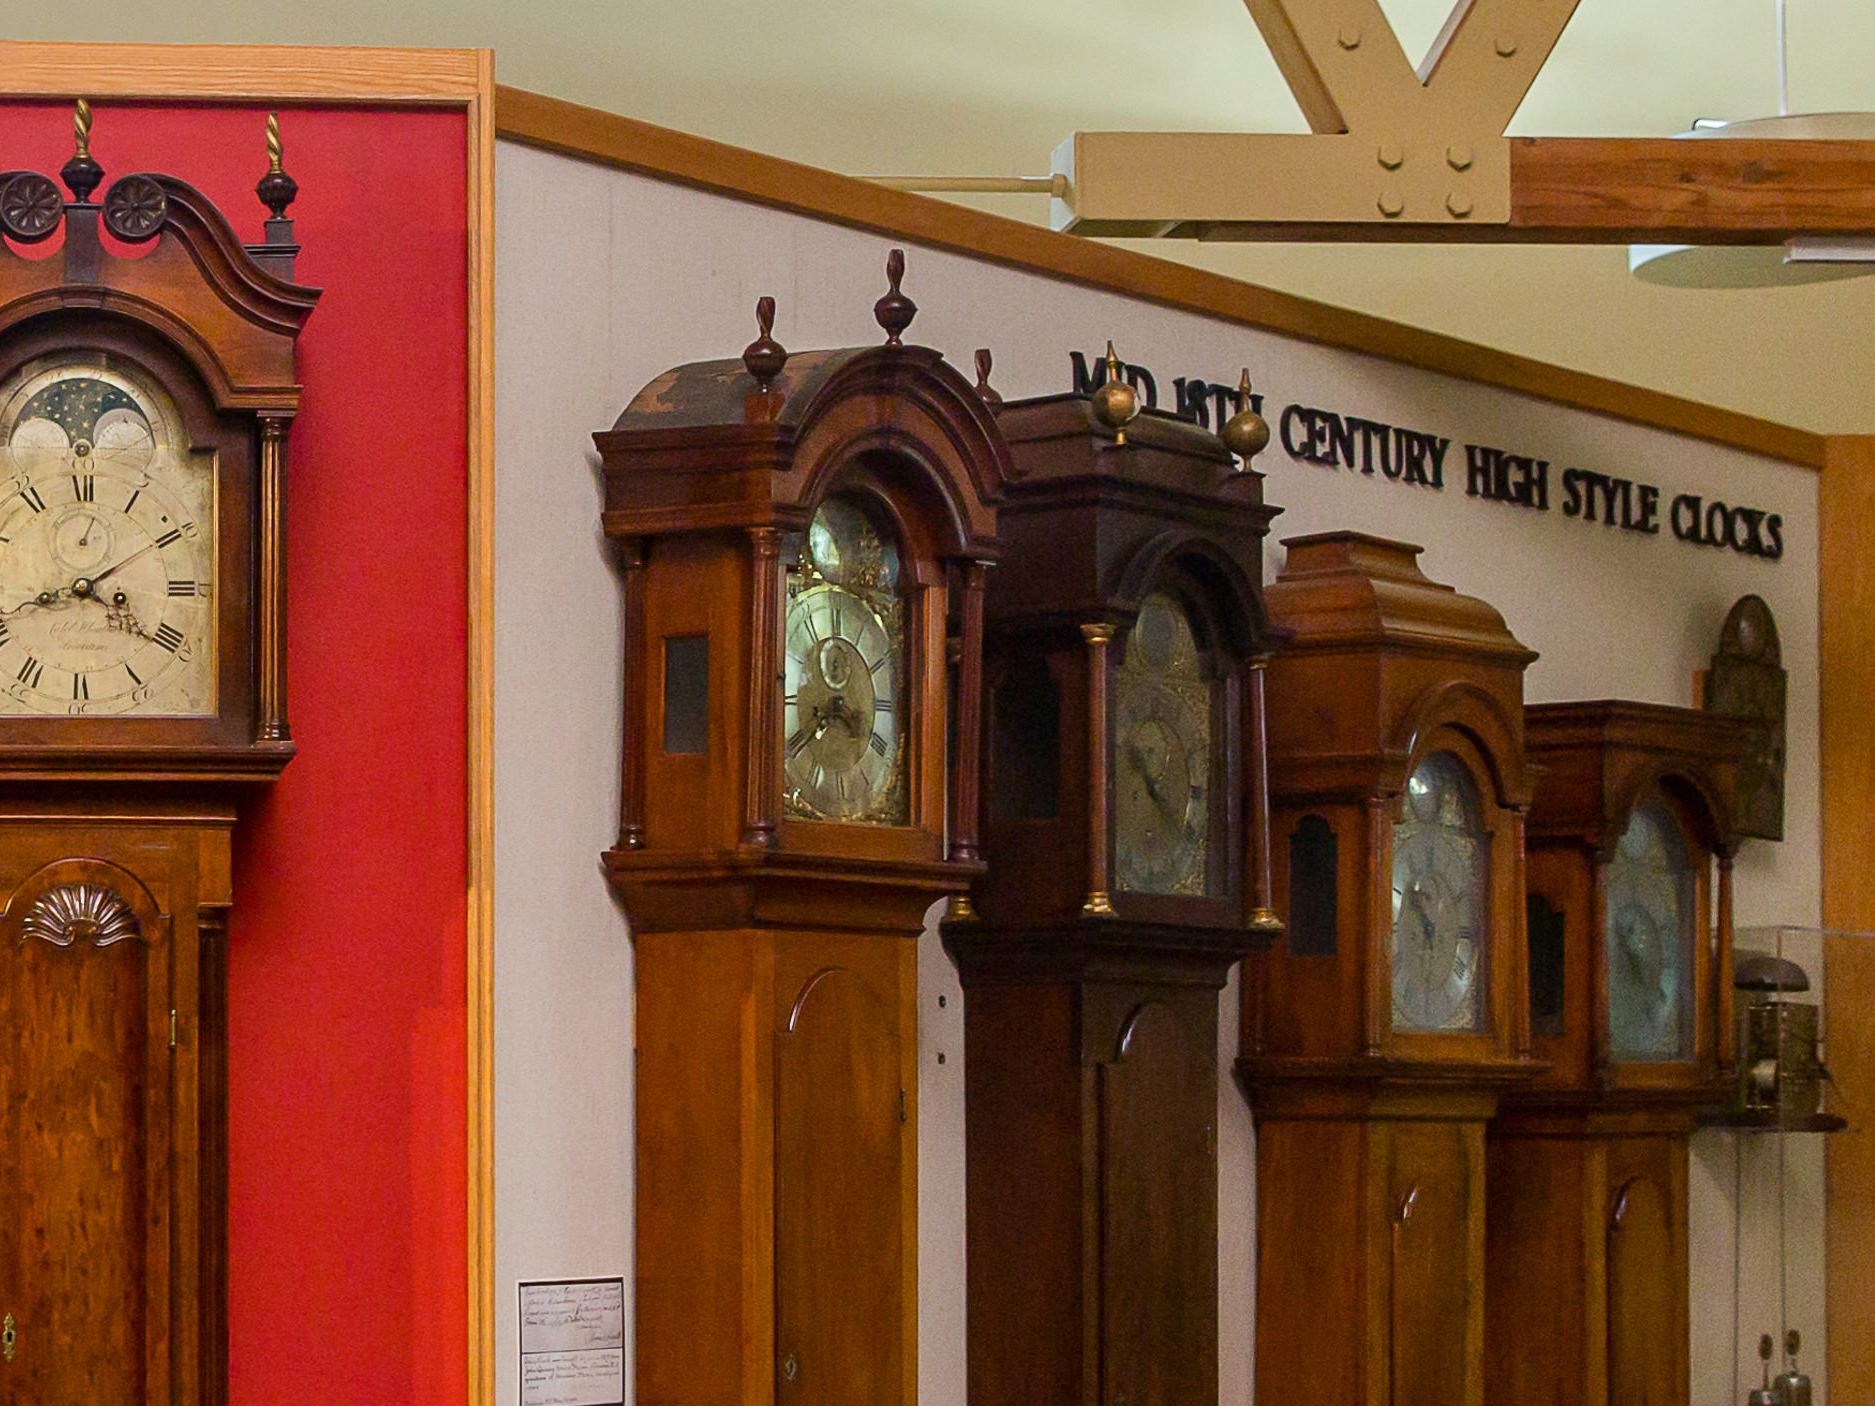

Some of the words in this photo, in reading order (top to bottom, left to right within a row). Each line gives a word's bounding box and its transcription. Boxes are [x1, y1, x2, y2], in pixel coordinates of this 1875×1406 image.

[1280, 403, 1451, 489] CENTURY
[1465, 443, 1550, 511] HIGH
[1562, 468, 1659, 534] STYLE
[1671, 494, 1784, 560] CLOCKS
